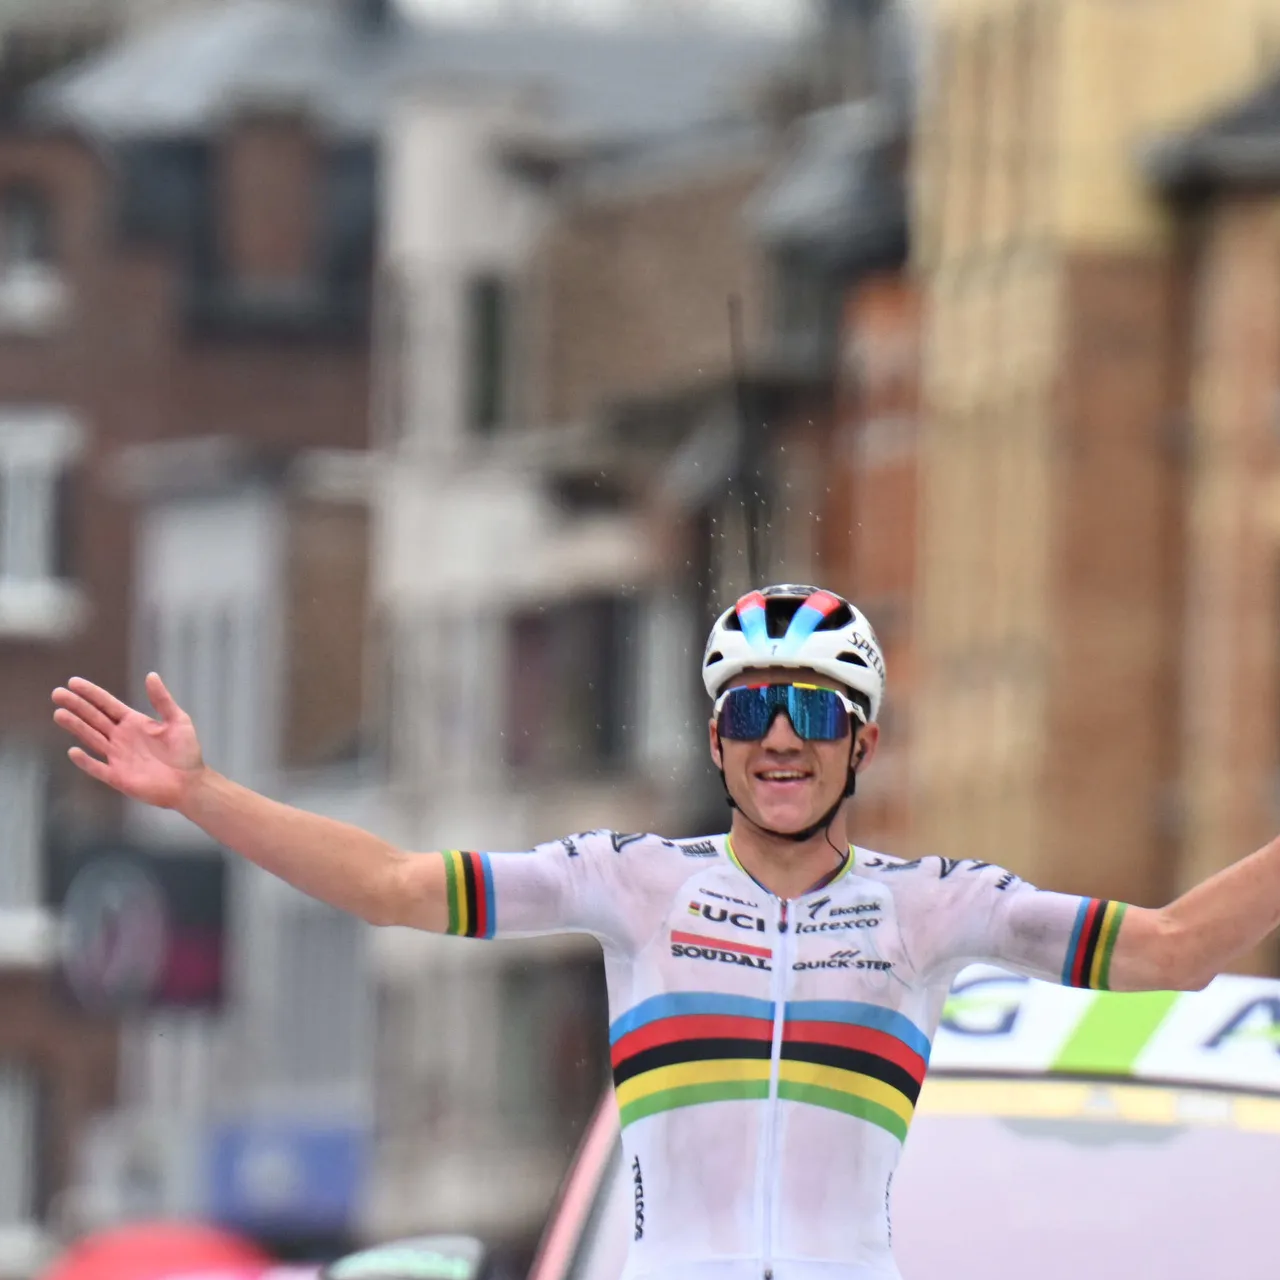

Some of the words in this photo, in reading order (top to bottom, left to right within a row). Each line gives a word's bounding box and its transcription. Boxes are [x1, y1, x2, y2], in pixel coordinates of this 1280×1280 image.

[702, 904, 766, 932] UCI
[795, 918, 880, 934] latexco
[671, 944, 773, 971] SOUDAL
